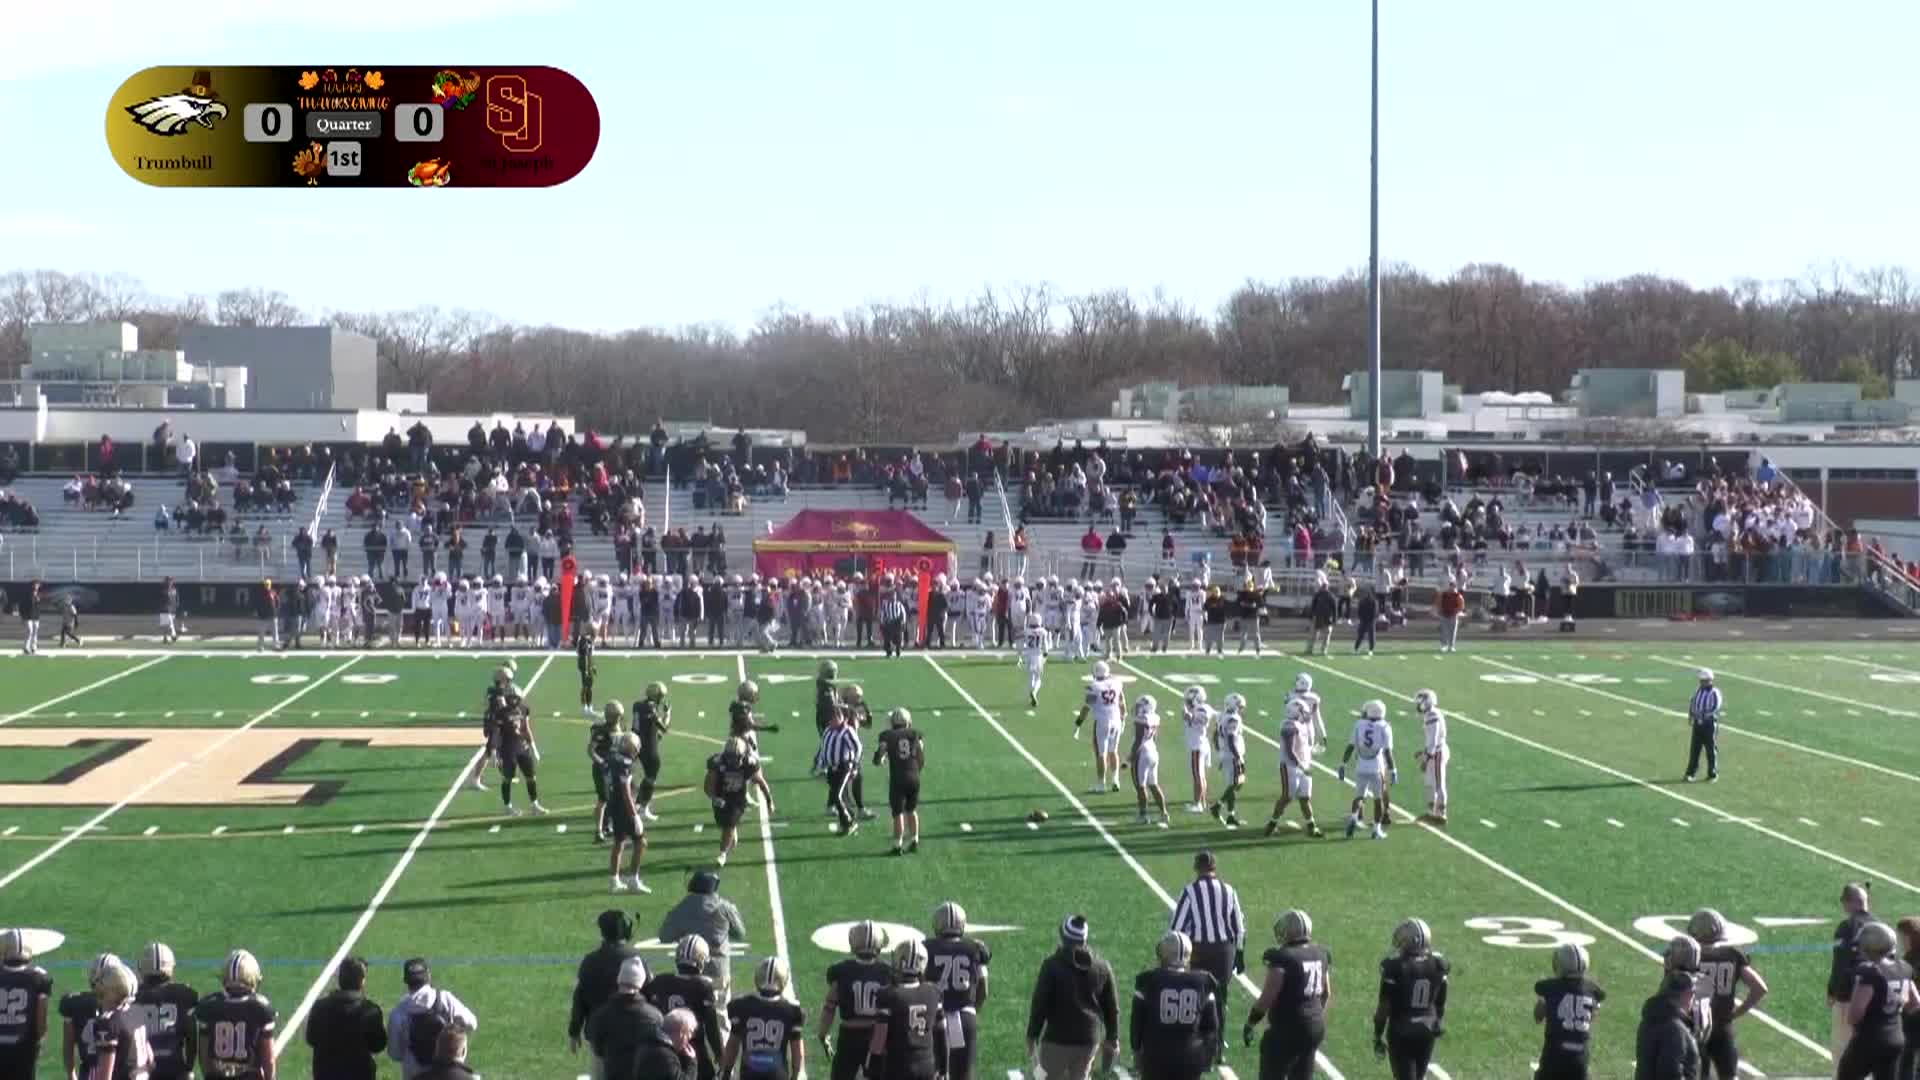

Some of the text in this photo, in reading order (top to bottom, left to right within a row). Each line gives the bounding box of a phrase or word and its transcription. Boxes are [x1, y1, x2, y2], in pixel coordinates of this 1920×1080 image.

[1363, 729, 1375, 748] 5
[934, 955, 970, 992] 76
[1302, 960, 1323, 996] 71
[852, 981, 880, 1015] 10
[1160, 988, 1198, 1025] 68
[1411, 979, 1431, 1009] 0
[908, 1004, 928, 1037] 5
[1557, 993, 1594, 1031] 45
[215, 1021, 248, 1057] 81
[746, 1017, 785, 1051] 29
